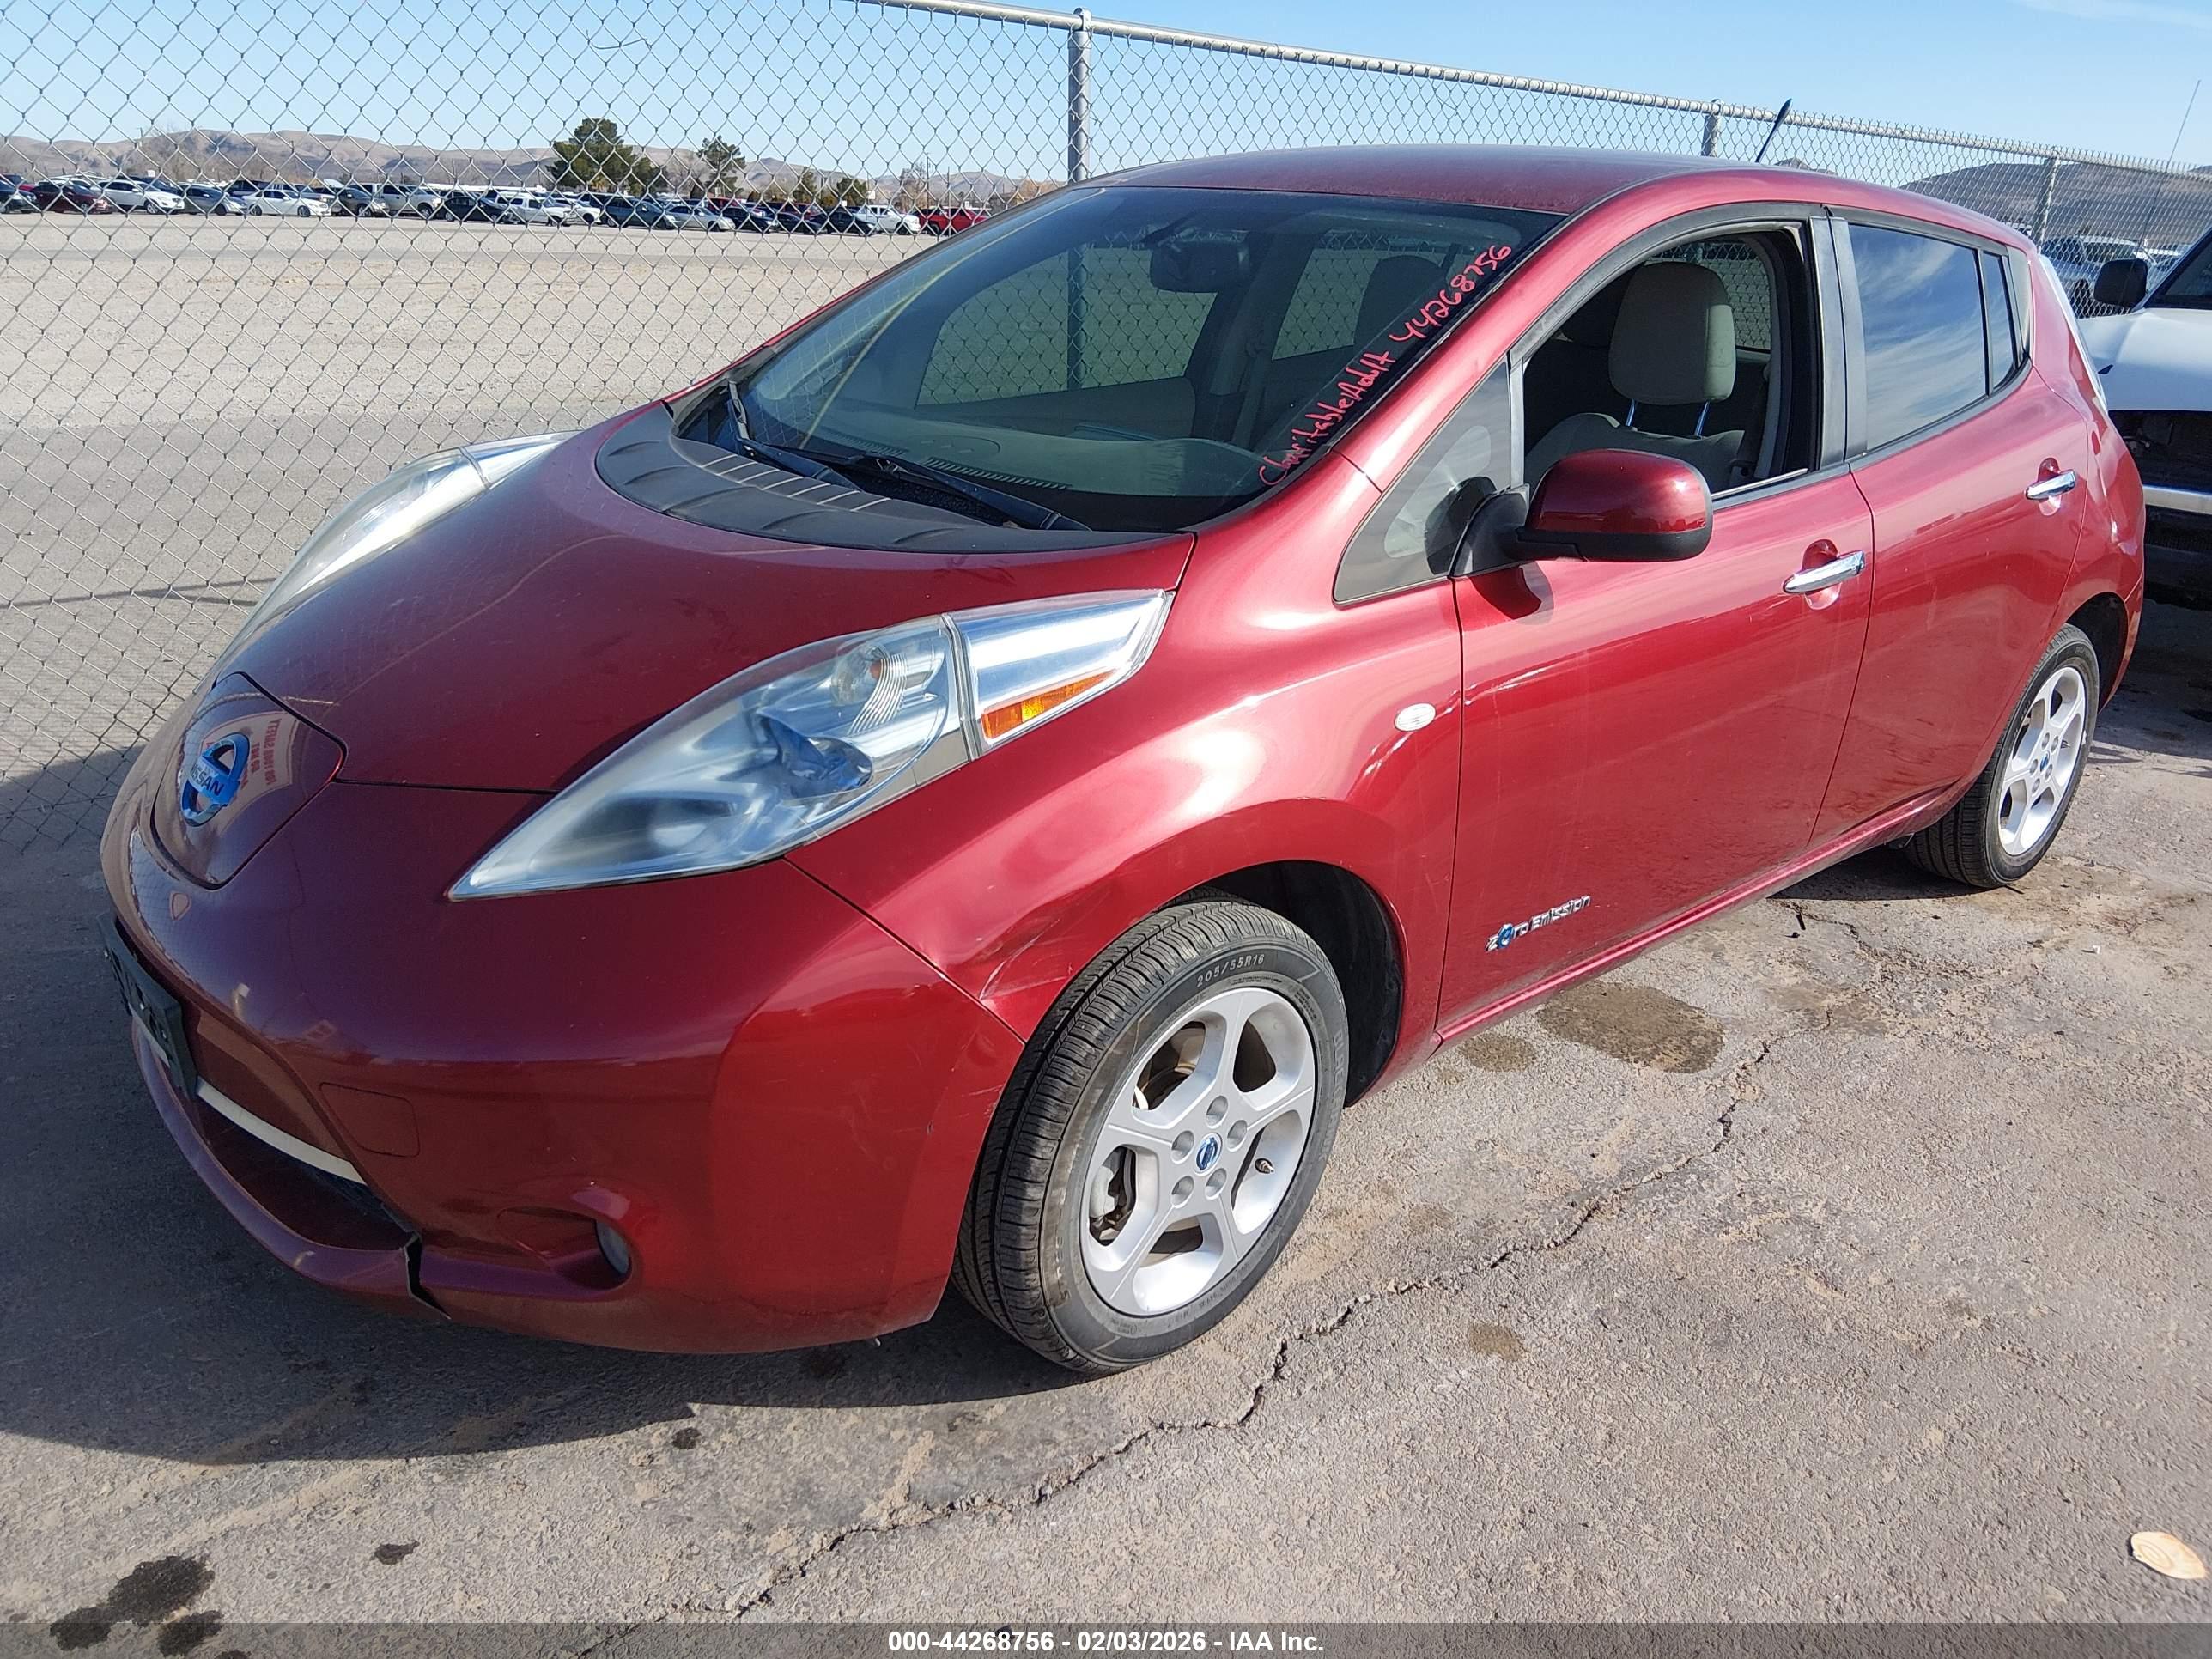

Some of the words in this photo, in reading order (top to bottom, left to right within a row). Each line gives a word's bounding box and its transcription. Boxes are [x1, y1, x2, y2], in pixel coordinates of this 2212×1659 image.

[1389, 245, 1512, 342] 44268756
[190, 763, 225, 796] NISSAN
[1528, 895, 1590, 933] Emission
[1196, 953, 1265, 988] 205/55R16
